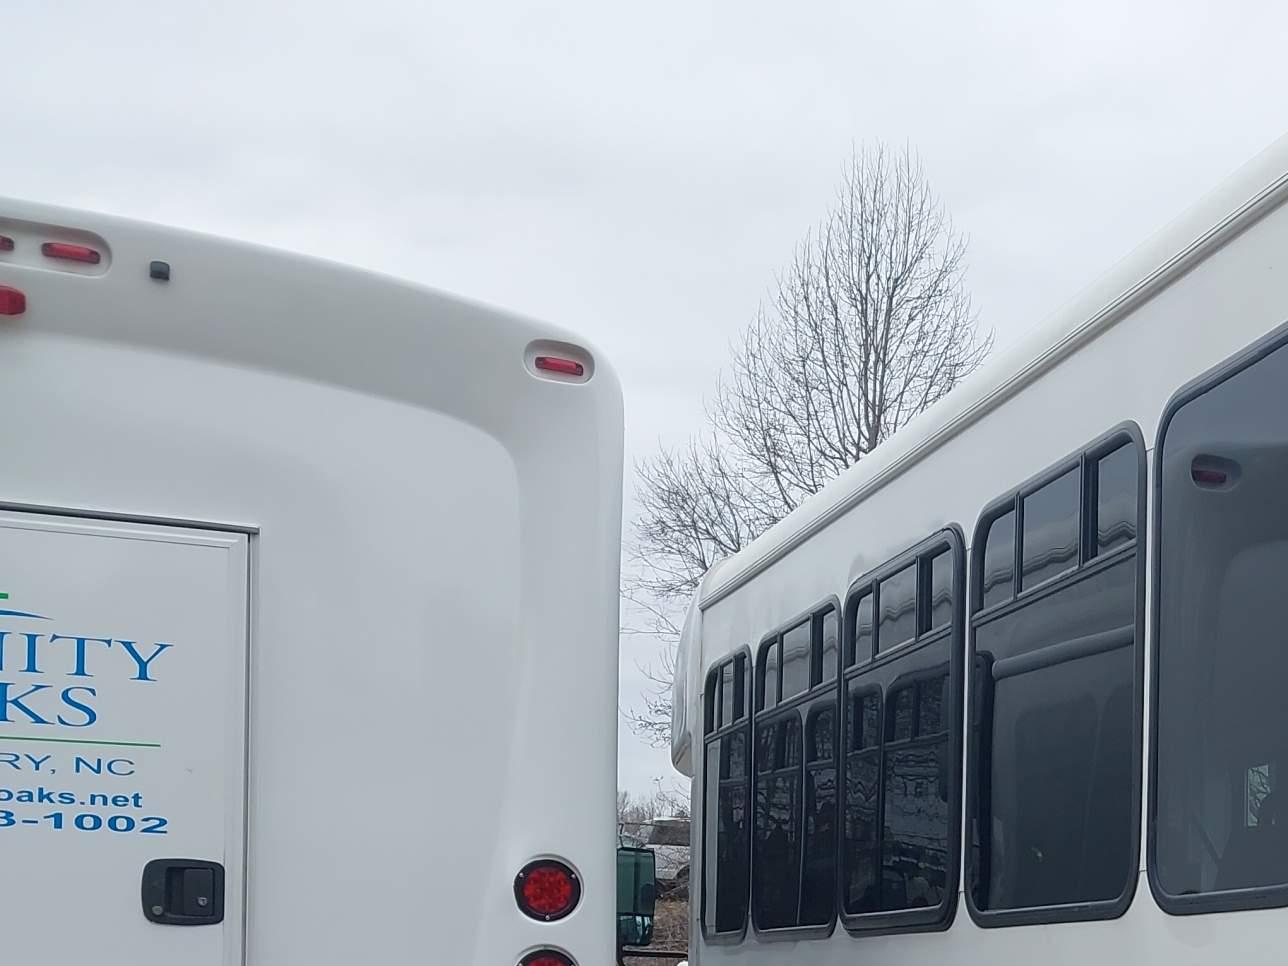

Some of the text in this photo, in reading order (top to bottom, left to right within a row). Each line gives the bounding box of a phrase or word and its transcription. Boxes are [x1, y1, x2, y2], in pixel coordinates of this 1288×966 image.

[0, 631, 174, 681] ITY
[0, 682, 97, 727] KS
[74, 757, 135, 776] NC
